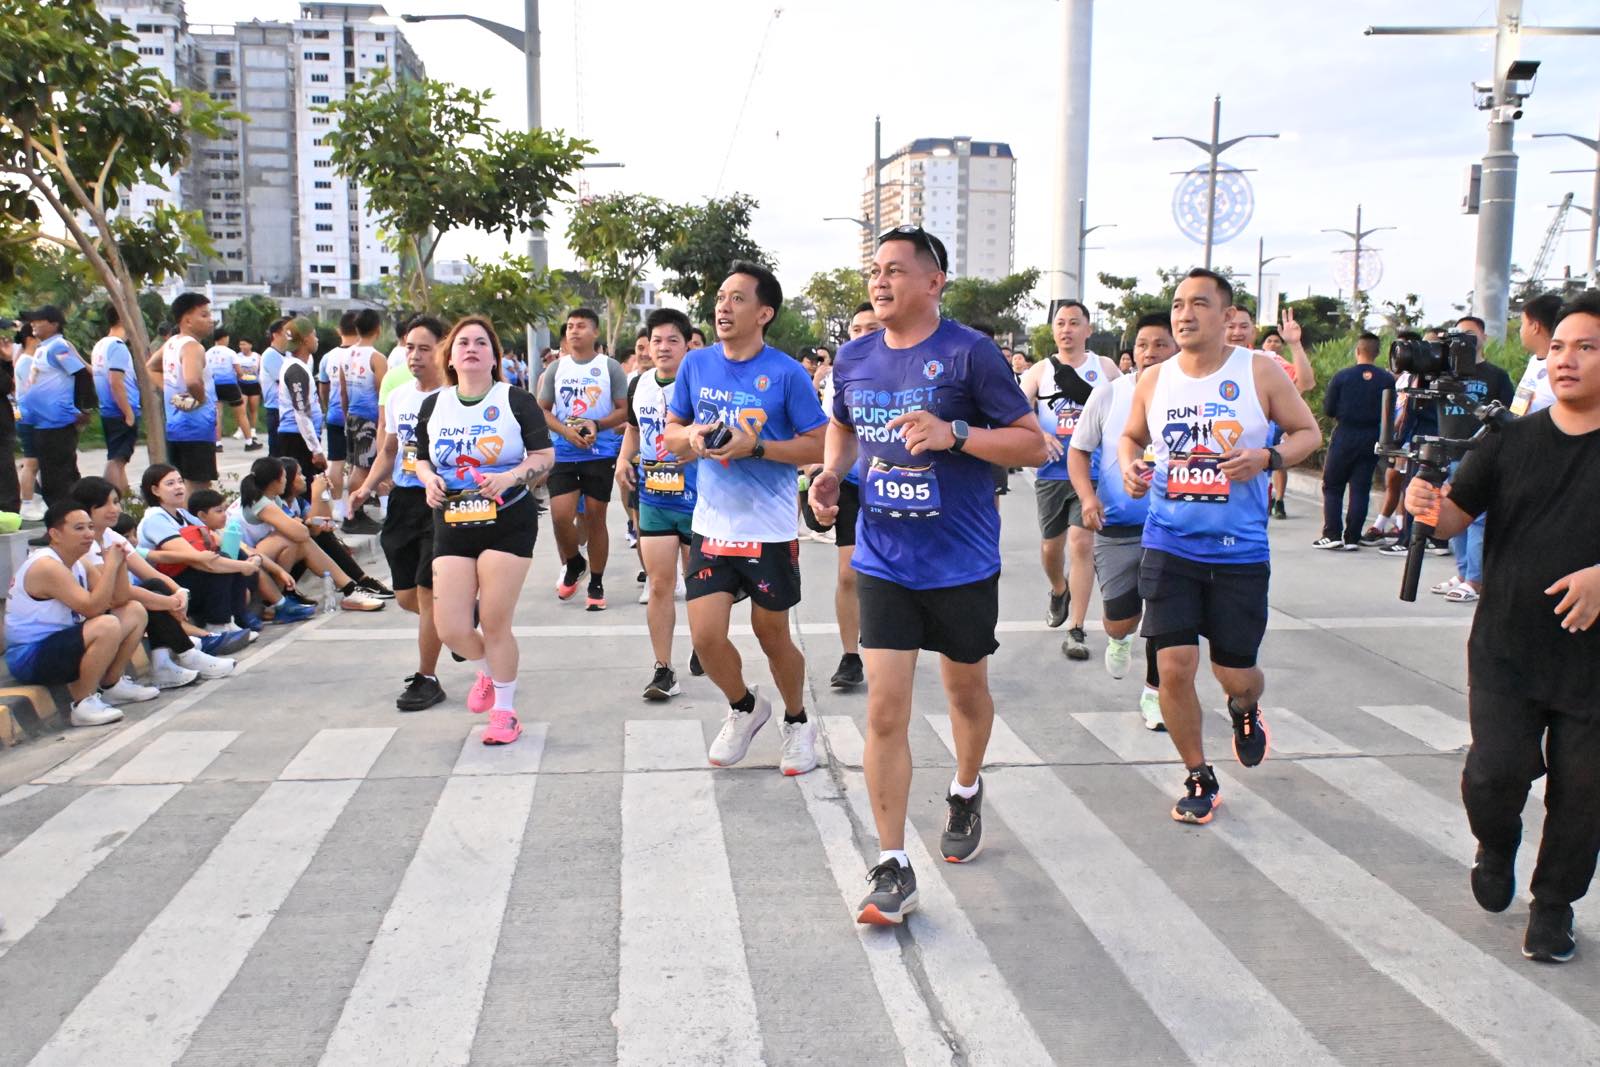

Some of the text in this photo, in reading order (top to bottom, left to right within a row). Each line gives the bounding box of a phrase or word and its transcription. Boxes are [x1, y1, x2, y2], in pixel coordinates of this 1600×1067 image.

[700, 387, 729, 402] RUN
[852, 404, 922, 425] PURS
[1167, 405, 1198, 421] RUN
[1203, 402, 1236, 418] 3Ps
[439, 425, 497, 437] RUN 3Ps
[855, 425, 906, 443] PROM
[646, 471, 680, 484] 5-6304
[1170, 466, 1228, 486] 10304
[874, 478, 930, 501] 1995
[449, 499, 490, 515] 5-6308
